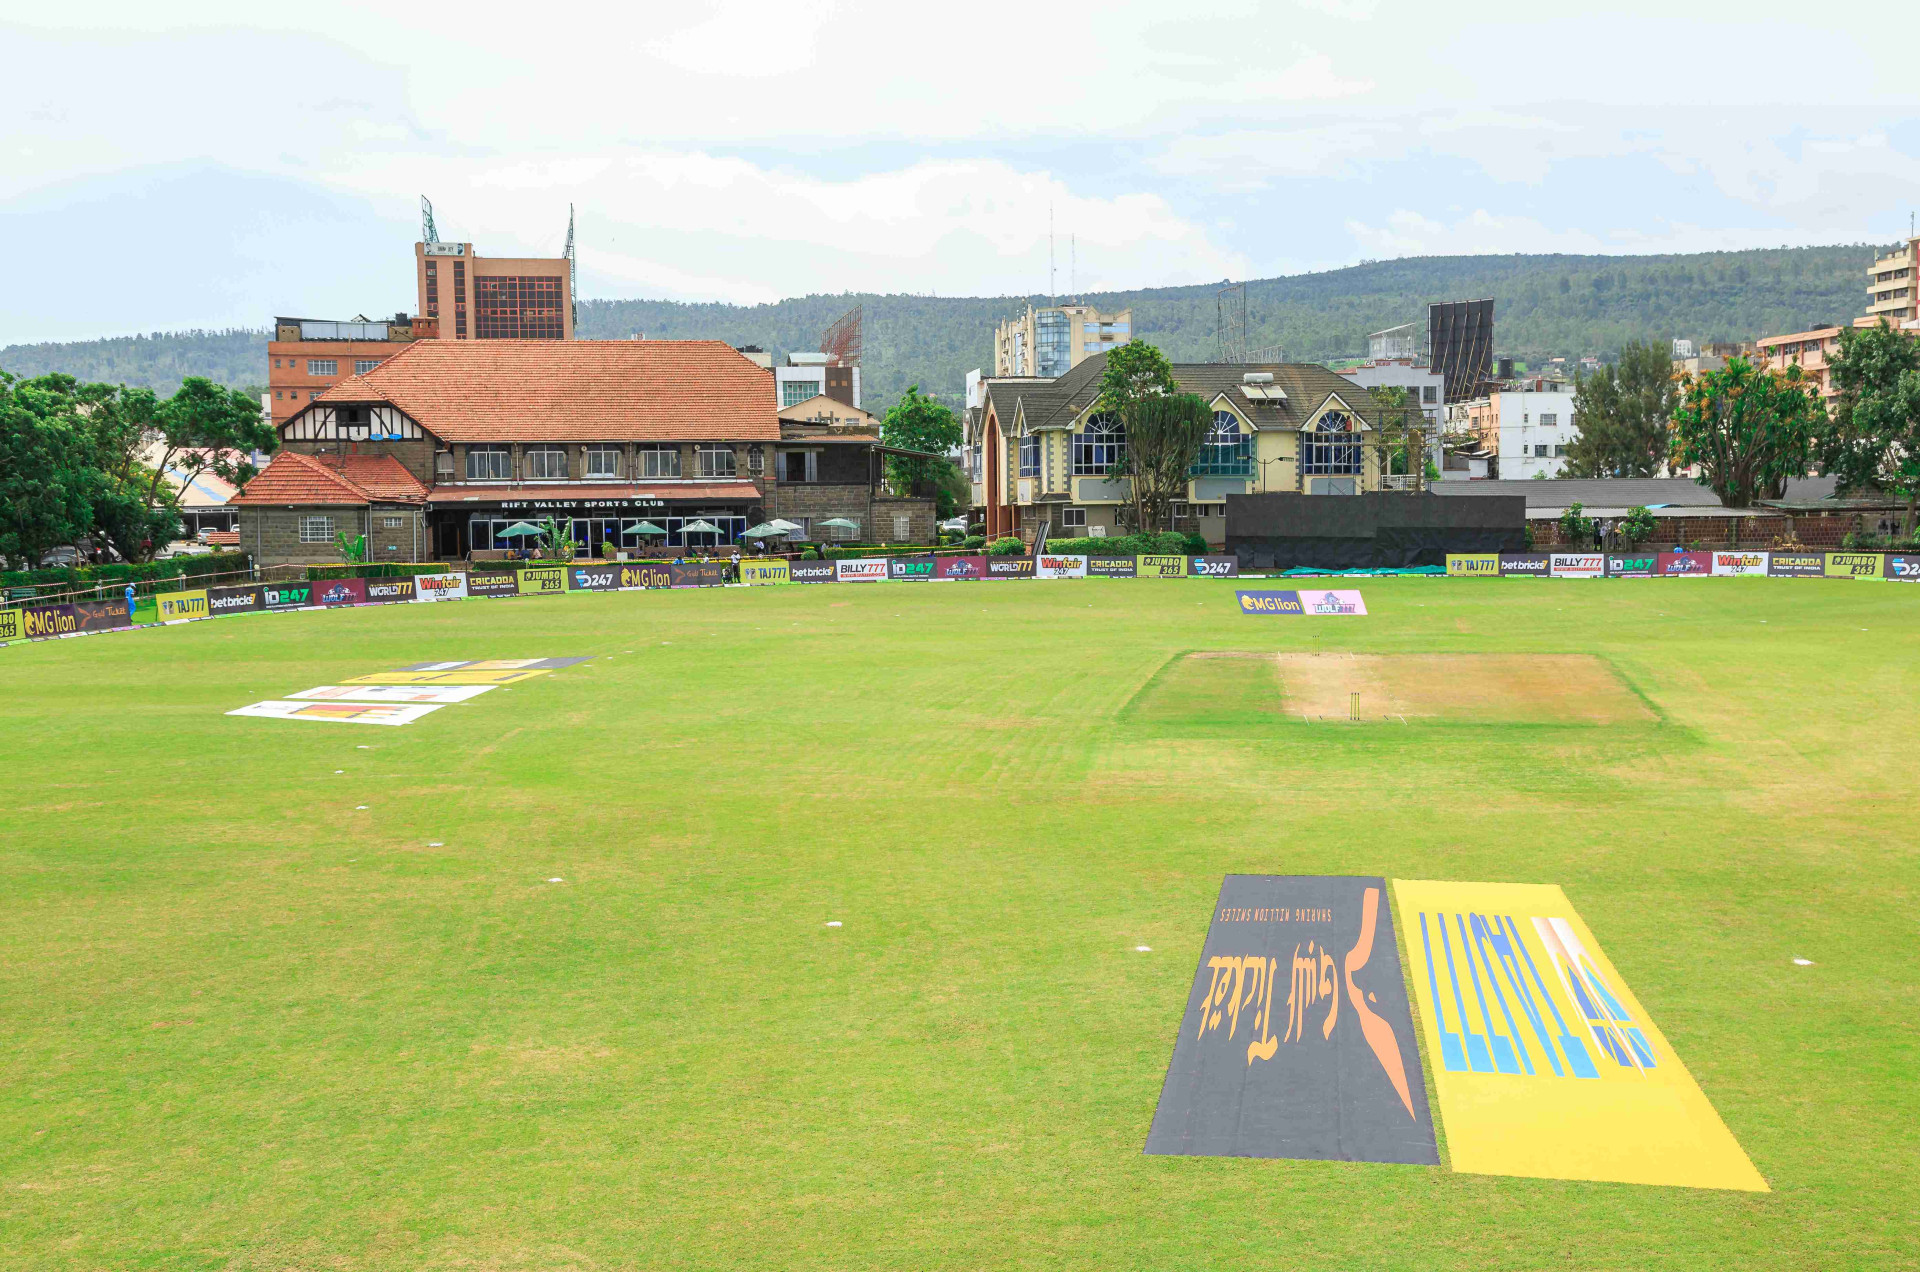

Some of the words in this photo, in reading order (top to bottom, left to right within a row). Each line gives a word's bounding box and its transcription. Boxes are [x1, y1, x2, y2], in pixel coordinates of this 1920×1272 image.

[584, 500, 629, 508] SPORTS
[1041, 557, 1083, 568] Winfair
[1150, 557, 1180, 566] JUMBO
[1717, 554, 1763, 566] Winfair
[1841, 556, 1875, 565] JUMBO
[1053, 567, 1070, 575] 247
[1162, 566, 1178, 574] 365
[1854, 565, 1873, 574] 365
[531, 571, 560, 580] JUMBO
[419, 576, 462, 590] Winfair
[543, 580, 560, 589] 365
[434, 588, 450, 596] 247
[1219, 908, 1252, 922] SMILES
[1254, 908, 1291, 922] MILLION
[1295, 908, 1332, 922] SHARING
